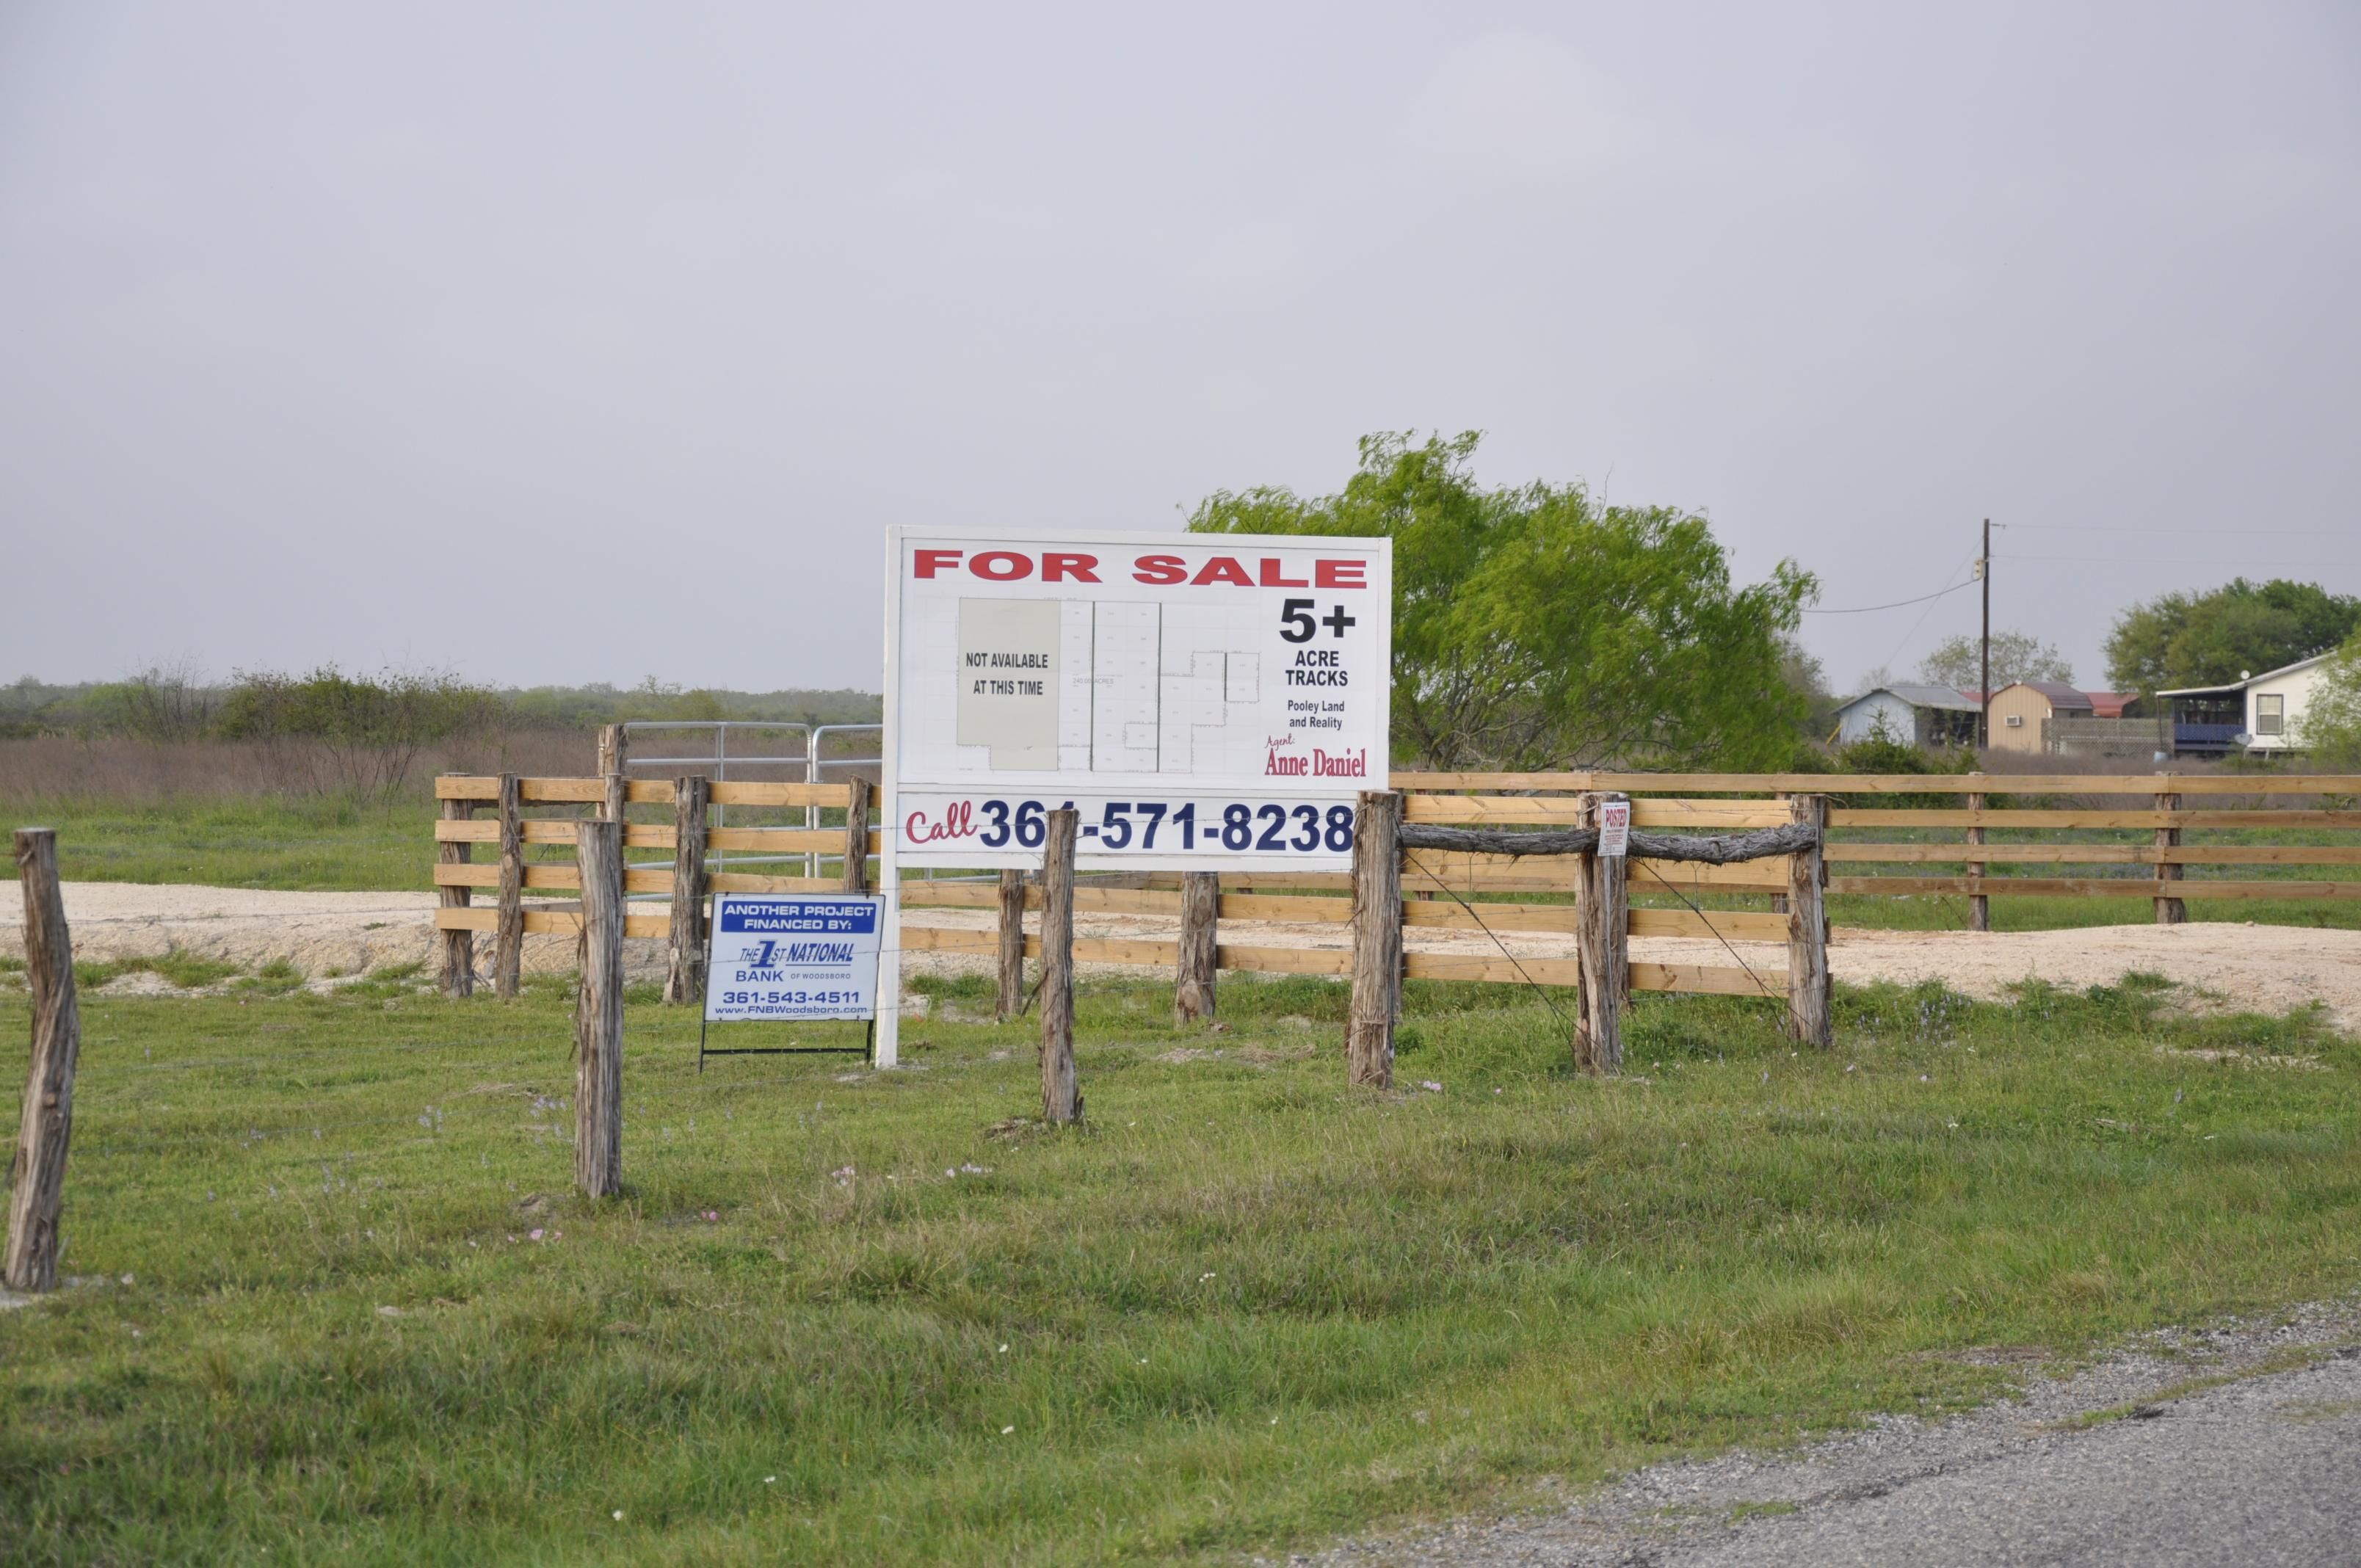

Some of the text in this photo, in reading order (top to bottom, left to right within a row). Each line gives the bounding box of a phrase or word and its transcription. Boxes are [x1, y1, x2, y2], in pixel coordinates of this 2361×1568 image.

[914, 549, 1367, 589] FOR SALE
[1279, 599, 1355, 643] 5+
[966, 653, 1048, 669] NOT AVAILABLE
[1295, 650, 1339, 667] ACRE
[1285, 670, 1348, 686] TRACKS
[973, 680, 1043, 695] AT THIS TIME
[1288, 700, 1344, 714] Pooley Land
[1289, 716, 1342, 730] and Reality
[1264, 733, 1296, 751] Agent:
[1264, 747, 1366, 777] Anne Daniel
[906, 800, 978, 843] Call
[1606, 808, 1627, 829] POSTED
[725, 905, 874, 917] ANOTHER PROJECT
[744, 919, 852, 930] FINANCED BY:
[740, 948, 761, 962] THE
[786, 943, 855, 962] NATIONAL
[736, 970, 784, 981] BANK
[722, 992, 859, 1003] 361-543-4511
[715, 1006, 867, 1014] www.FNBWoodsboro.com
